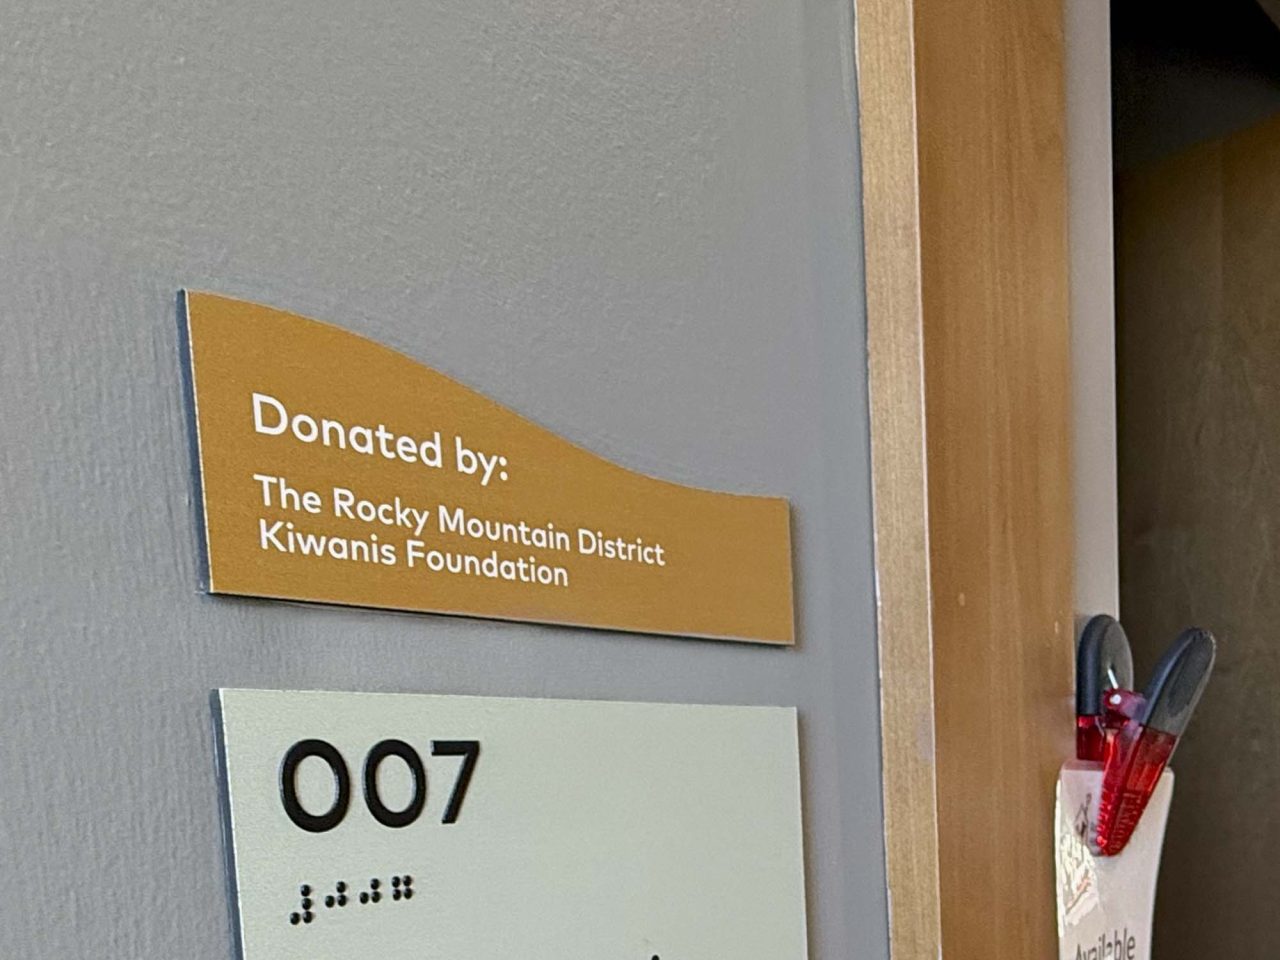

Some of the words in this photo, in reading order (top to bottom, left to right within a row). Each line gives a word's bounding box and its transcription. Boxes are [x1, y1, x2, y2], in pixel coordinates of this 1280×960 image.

[253, 393, 443, 468] Donated
[456, 437, 508, 487] by:
[254, 474, 321, 514] The
[334, 488, 429, 536] Rocky
[439, 506, 570, 552] Mountain
[579, 529, 666, 566] District
[260, 518, 396, 566] Kiwanis
[407, 540, 568, 587] Foundation
[279, 739, 480, 833] 007
